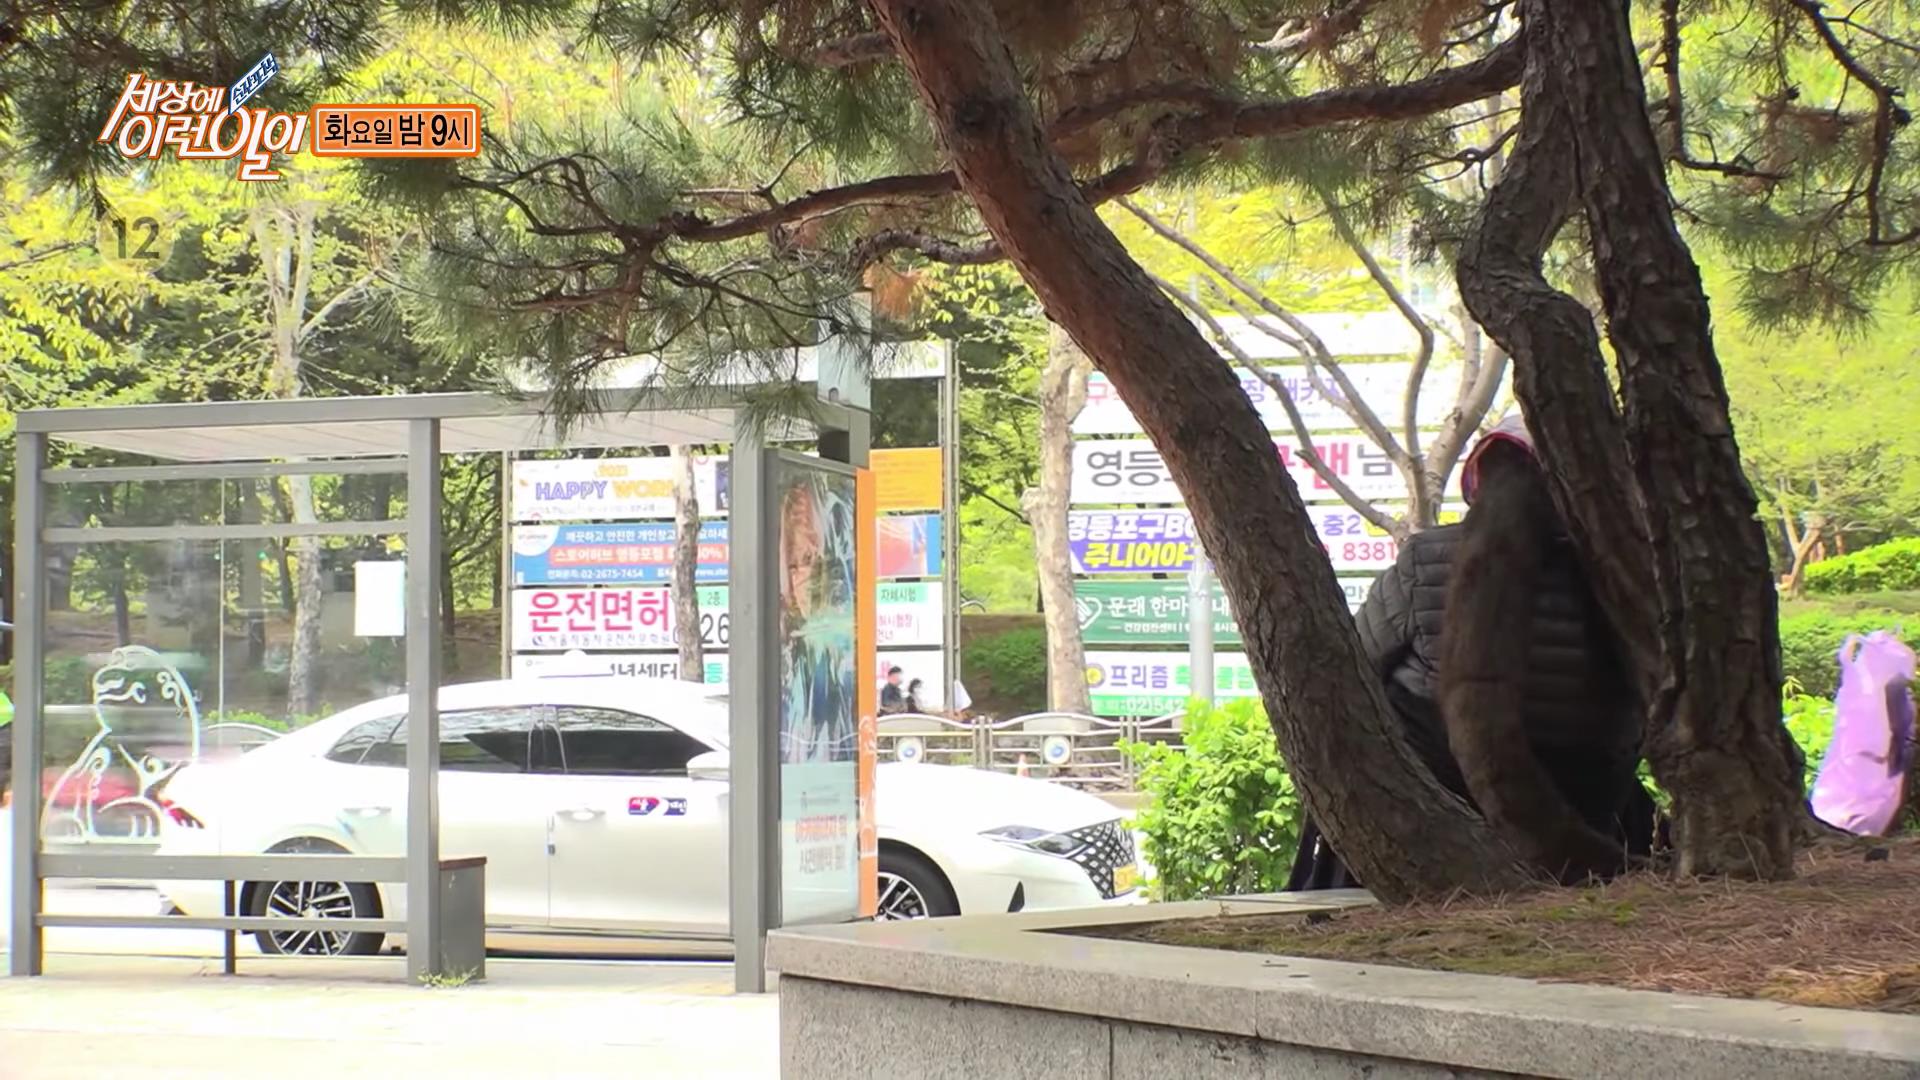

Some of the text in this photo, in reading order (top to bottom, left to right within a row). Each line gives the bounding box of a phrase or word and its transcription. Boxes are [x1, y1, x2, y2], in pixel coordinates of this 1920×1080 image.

[1087, 450, 1175, 487] 영등
[535, 480, 608, 500] HAPPY
[528, 590, 671, 632] 운전면허
[1110, 664, 1168, 689] 프리즘
